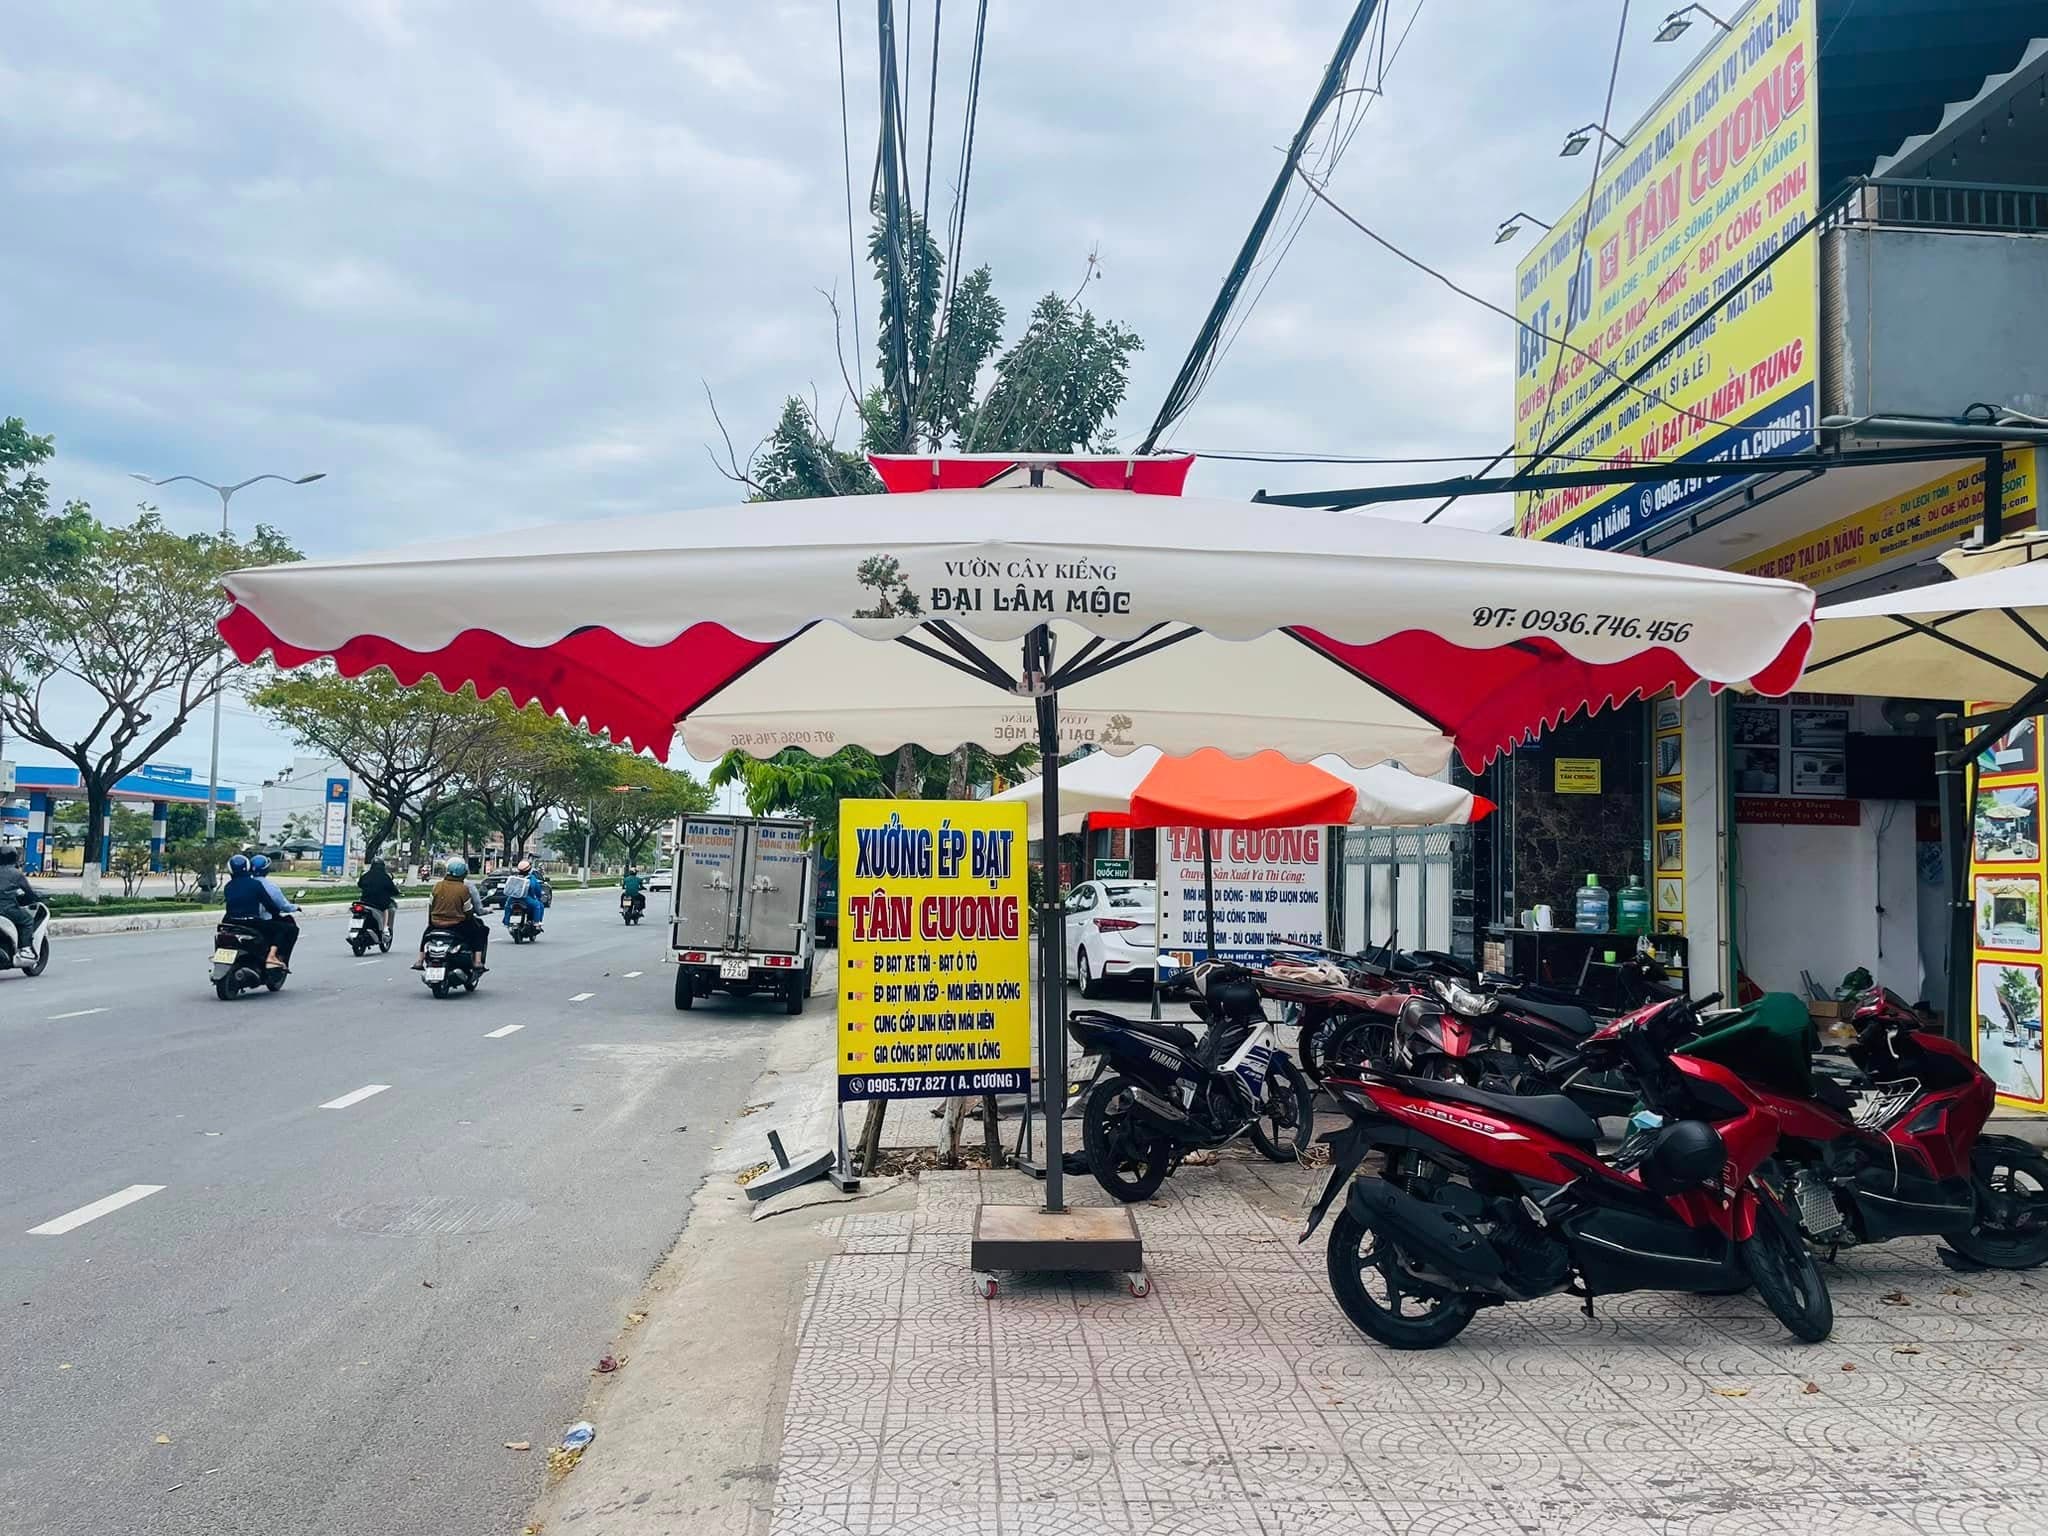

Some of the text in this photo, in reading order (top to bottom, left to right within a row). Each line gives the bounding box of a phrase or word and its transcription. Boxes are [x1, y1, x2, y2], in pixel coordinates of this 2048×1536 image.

[1539, 251, 1547, 283] TY
[1655, 115, 1675, 164] MẠI
[1678, 95, 1691, 140] VÀ
[1694, 68, 1718, 124] DỊCH
[1722, 49, 1737, 100] VỤ
[1741, 8, 1772, 76] TỔNG
[1626, 39, 1805, 264] TÂN CƯƠNG
[1607, 316, 1621, 351] CHE
[1700, 231, 1721, 274] BẠT
[1726, 196, 1761, 253] CÔNG
[1766, 159, 1806, 220] TRÌNH
[1622, 271, 1638, 299] CHE
[1662, 233, 1680, 264] CHE
[1684, 204, 1711, 245] SÔNG
[1625, 342, 1638, 367] BẠT
[1643, 326, 1658, 354] CHE
[1684, 285, 1708, 321] CÔNG
[1713, 257, 1744, 299] TRÌNH
[1519, 297, 1549, 377] BẠT
[1641, 421, 1659, 460] VẢI
[1662, 411, 1684, 454] BẠT
[1711, 366, 1746, 420] MIỀN
[1750, 338, 1802, 399] TRUNG
[1591, 517, 1603, 545] ĐÀ
[1605, 505, 1630, 538] NẴNG
[945, 556, 1117, 580] VƯỜN CÂY KIỂNG
[931, 583, 1130, 617] ĐẠI LÂM MỘC
[1472, 606, 1694, 643] ĐT: 0936.746.456
[855, 812, 932, 878] XƯỞNG
[971, 830, 1013, 889] BẠT
[1213, 867, 1228, 880] Sản
[1231, 868, 1249, 880] Xuất
[1252, 870, 1263, 881] Và
[1265, 870, 1279, 881] Thi
[1215, 890, 1222, 901] DI
[1224, 888, 1243, 904] ĐỘNG
[1250, 888, 1263, 902] MÁI
[1265, 886, 1278, 902] XẾP
[849, 887, 1019, 941] TÂN CƯƠNG
[1183, 910, 1195, 925] BẠT
[1227, 908, 1245, 923] CÔNG
[874, 950, 977, 976] ÉP BẠT XE TẢI BẠT Ô TÔ
[874, 978, 1020, 1007] ÉP BẠT MÁI XẾP MÁI HIÊN DI ĐỘNG
[874, 1008, 995, 1035] CUNG CẤP LINH KIỆN MÁI HIÊN
[874, 1045, 888, 1064] GIA
[891, 1041, 915, 1063] CÔNG
[917, 1044, 932, 1066] BẠT
[967, 1043, 976, 1060] NI
[978, 1038, 1001, 1060] LÔNG
[1149, 1048, 1181, 1072] YAMAHA
[867, 1073, 1013, 1093] 0905.797.827 A. CƯƠNG
[1406, 1103, 1495, 1133] AIRBLADE
